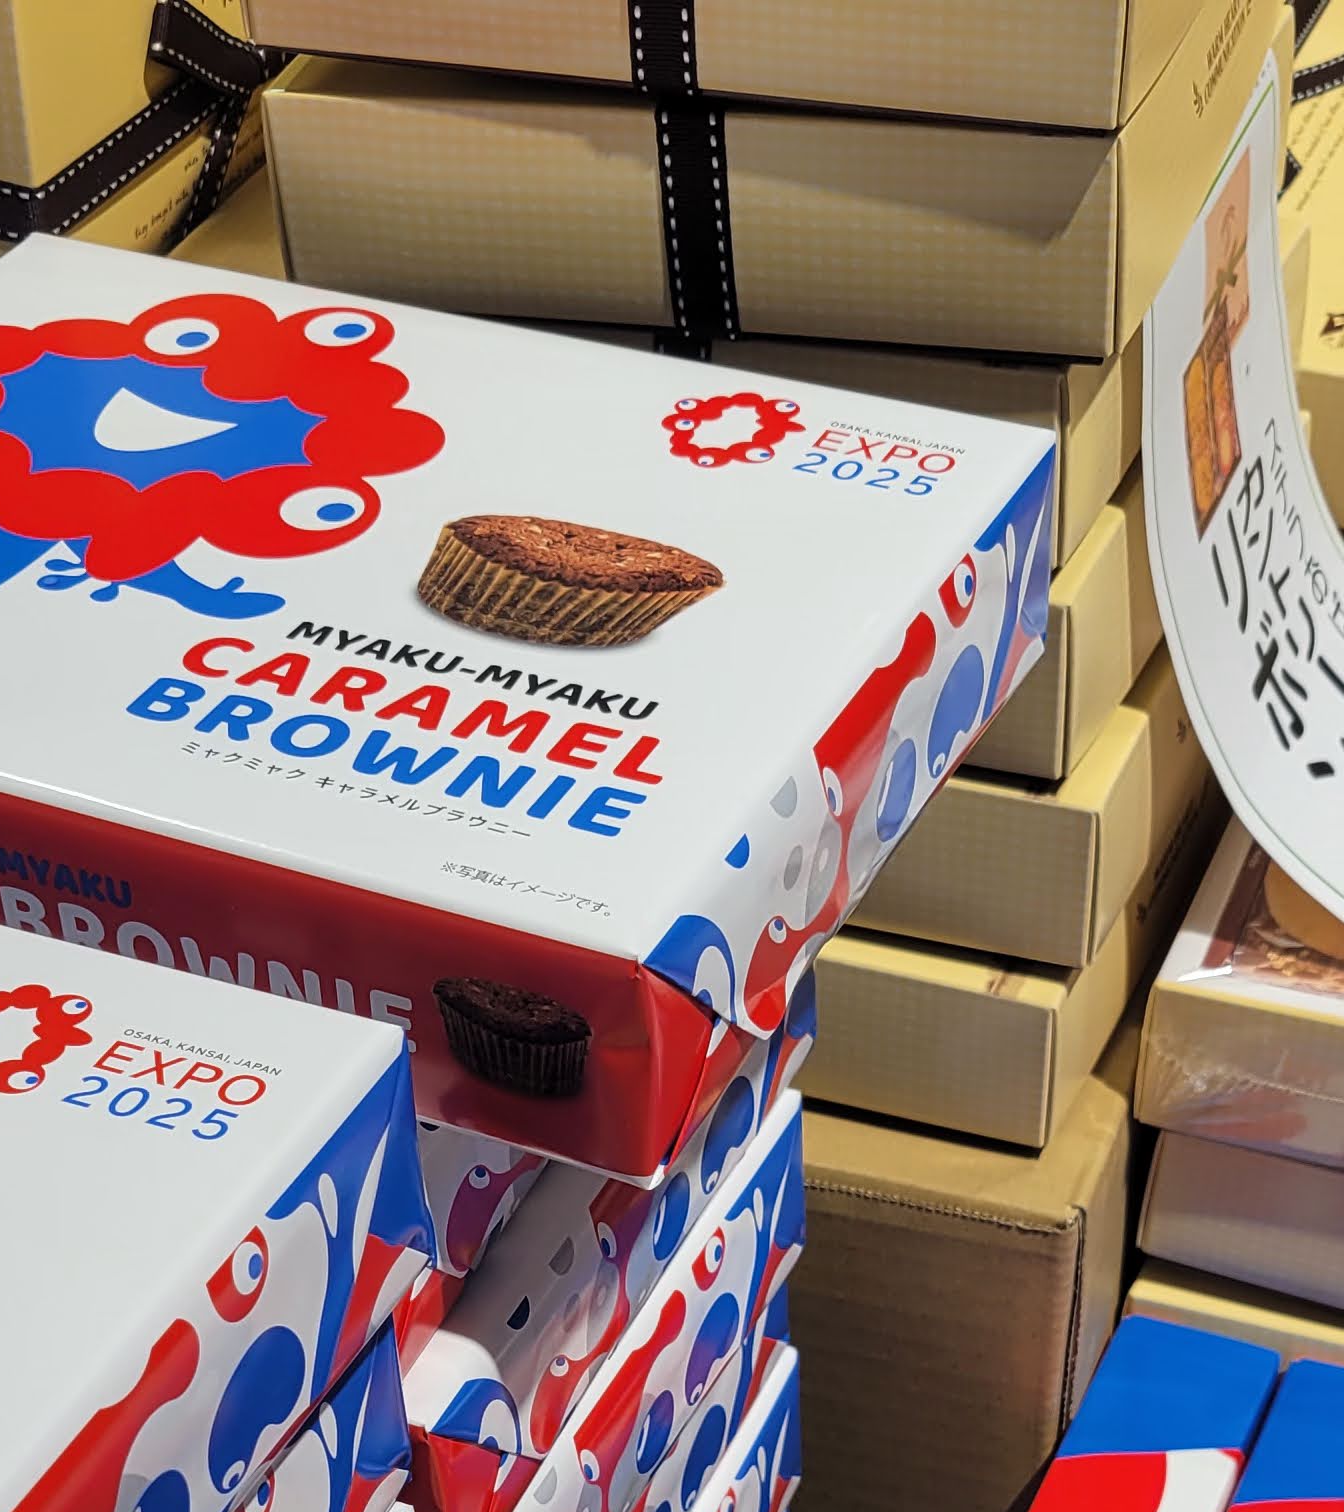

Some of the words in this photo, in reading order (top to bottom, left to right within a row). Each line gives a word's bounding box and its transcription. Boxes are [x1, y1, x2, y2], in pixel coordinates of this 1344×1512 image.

[811, 429, 956, 474] EXPO
[830, 420, 873, 437] OSAKA,
[925, 441, 966, 456] JAPAN
[792, 452, 939, 496] 2025
[286, 621, 659, 721] MYAKU-MYAKU
[182, 637, 664, 785] CARAMEL
[125, 677, 648, 838] BROWNIE
[315, 775, 533, 840] キャラメルブラウニー
[92, 1040, 268, 1106] EXPO
[123, 1028, 173, 1049] OSAKA,
[176, 1042, 231, 1064] KANSAI,
[233, 1057, 283, 1077] JAPAN
[61, 1075, 239, 1140] 2025
